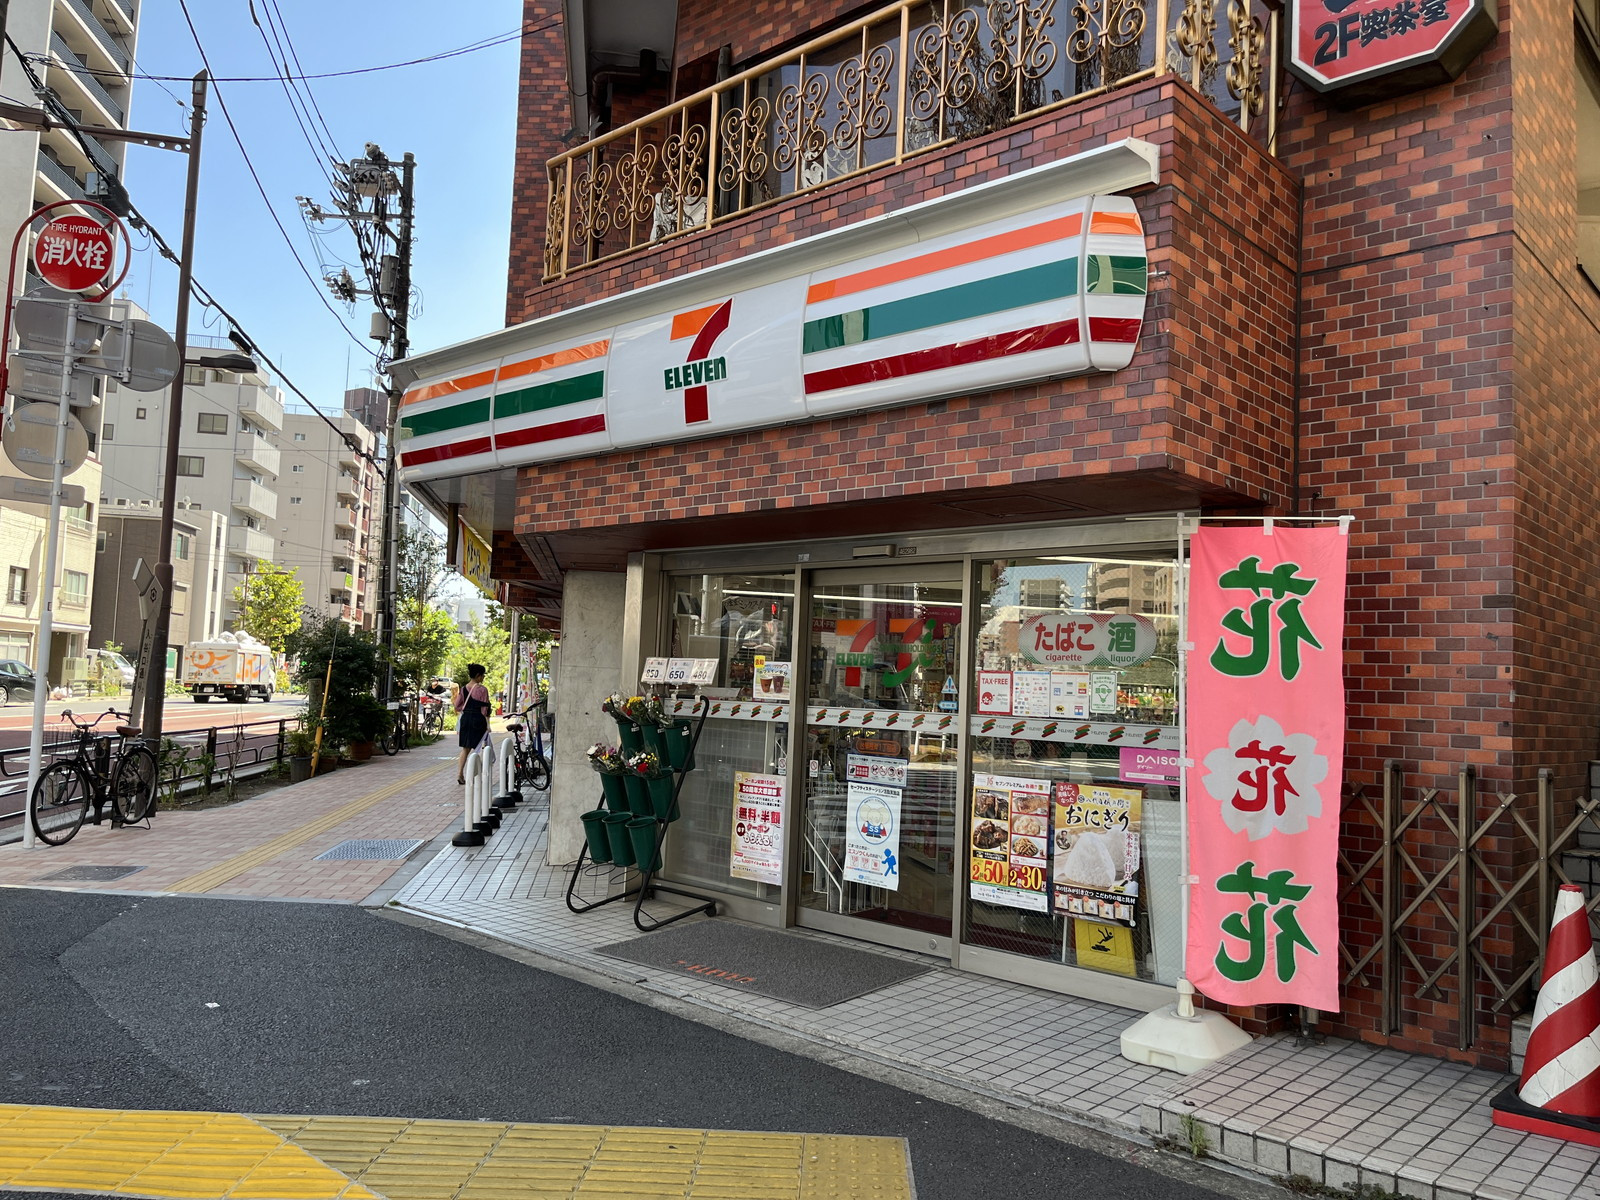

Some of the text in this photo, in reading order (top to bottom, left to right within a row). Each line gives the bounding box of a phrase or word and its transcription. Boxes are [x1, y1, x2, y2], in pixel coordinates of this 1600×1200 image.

[51, 223, 103, 236] FIRE HYDRANT
[41, 235, 108, 270] 消火栓
[1034, 620, 1136, 653] たばこ 酒
[1045, 653, 1137, 664] cigarette liquor
[646, 669, 659, 678] 850
[669, 670, 684, 679] 650
[1136, 754, 1177, 766] DAISO
[1066, 804, 1129, 832] おにぎり
[868, 825, 879, 833] SS
